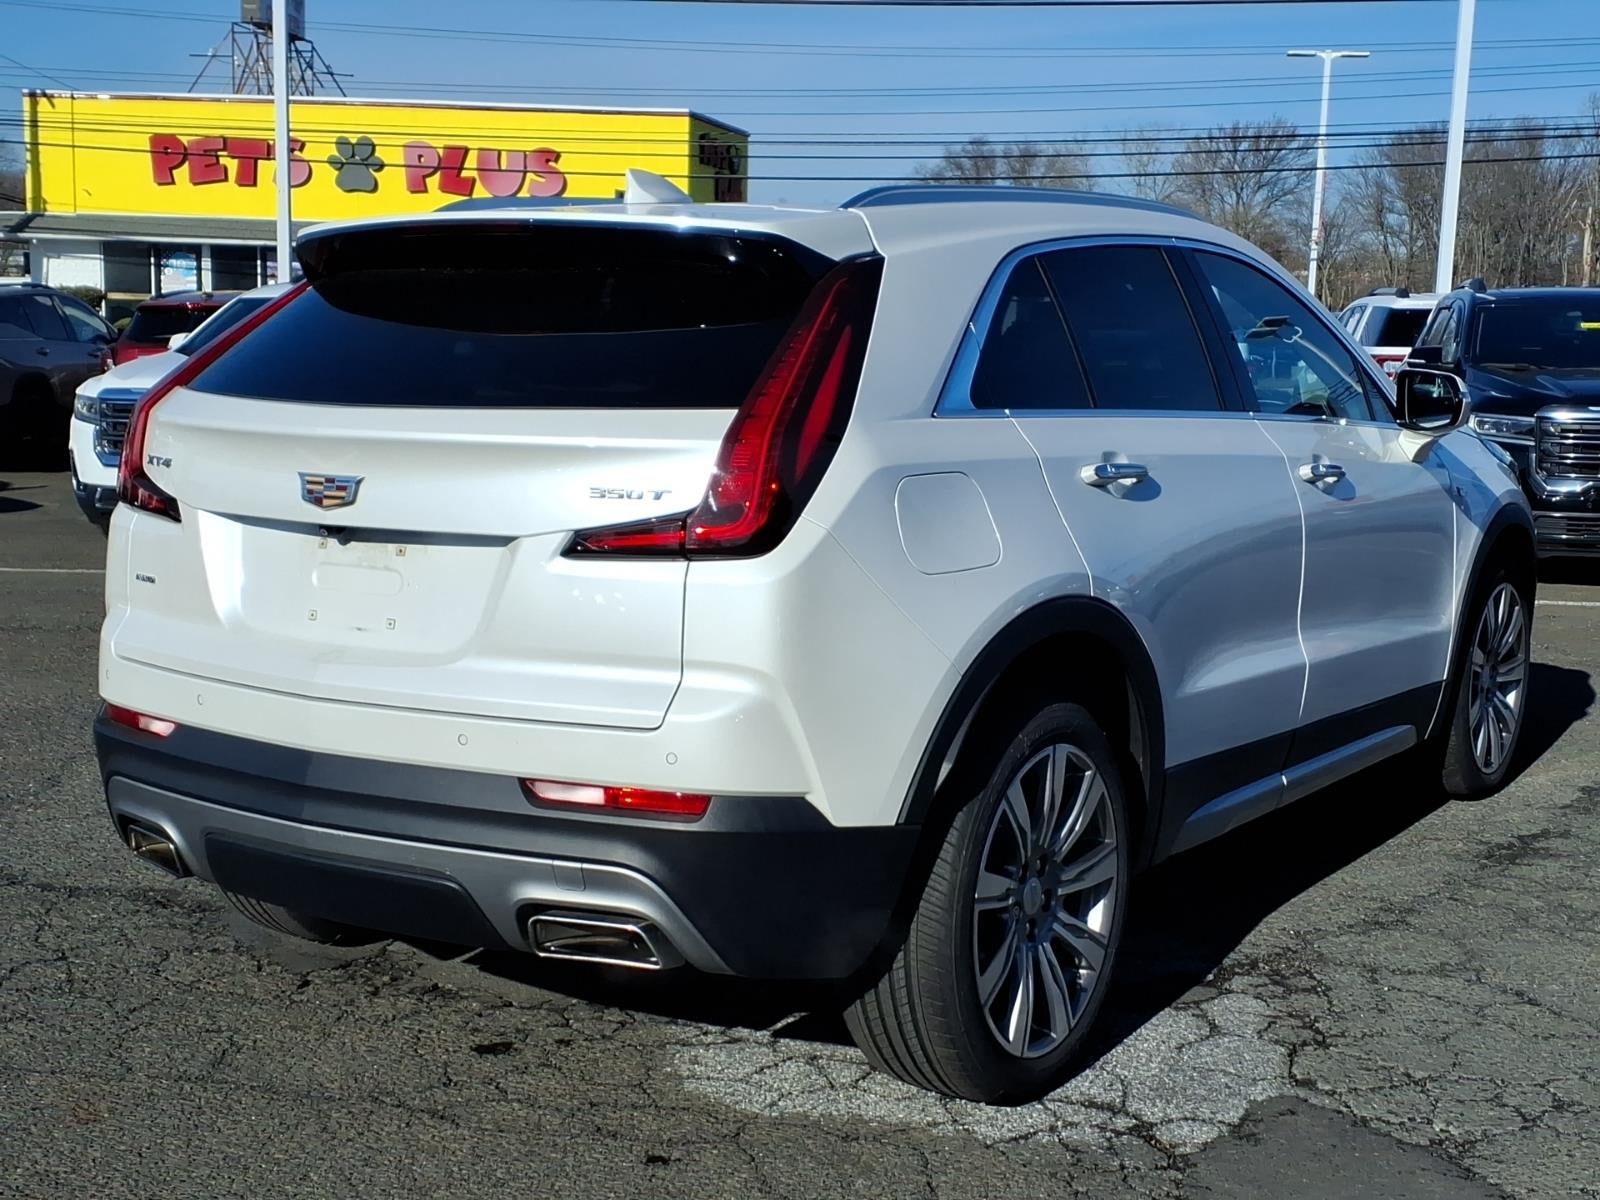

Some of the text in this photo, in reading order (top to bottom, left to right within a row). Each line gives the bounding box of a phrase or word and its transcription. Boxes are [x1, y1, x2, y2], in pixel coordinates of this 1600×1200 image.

[149, 133, 567, 198] PETS PLUS
[147, 454, 172, 469] XT4
